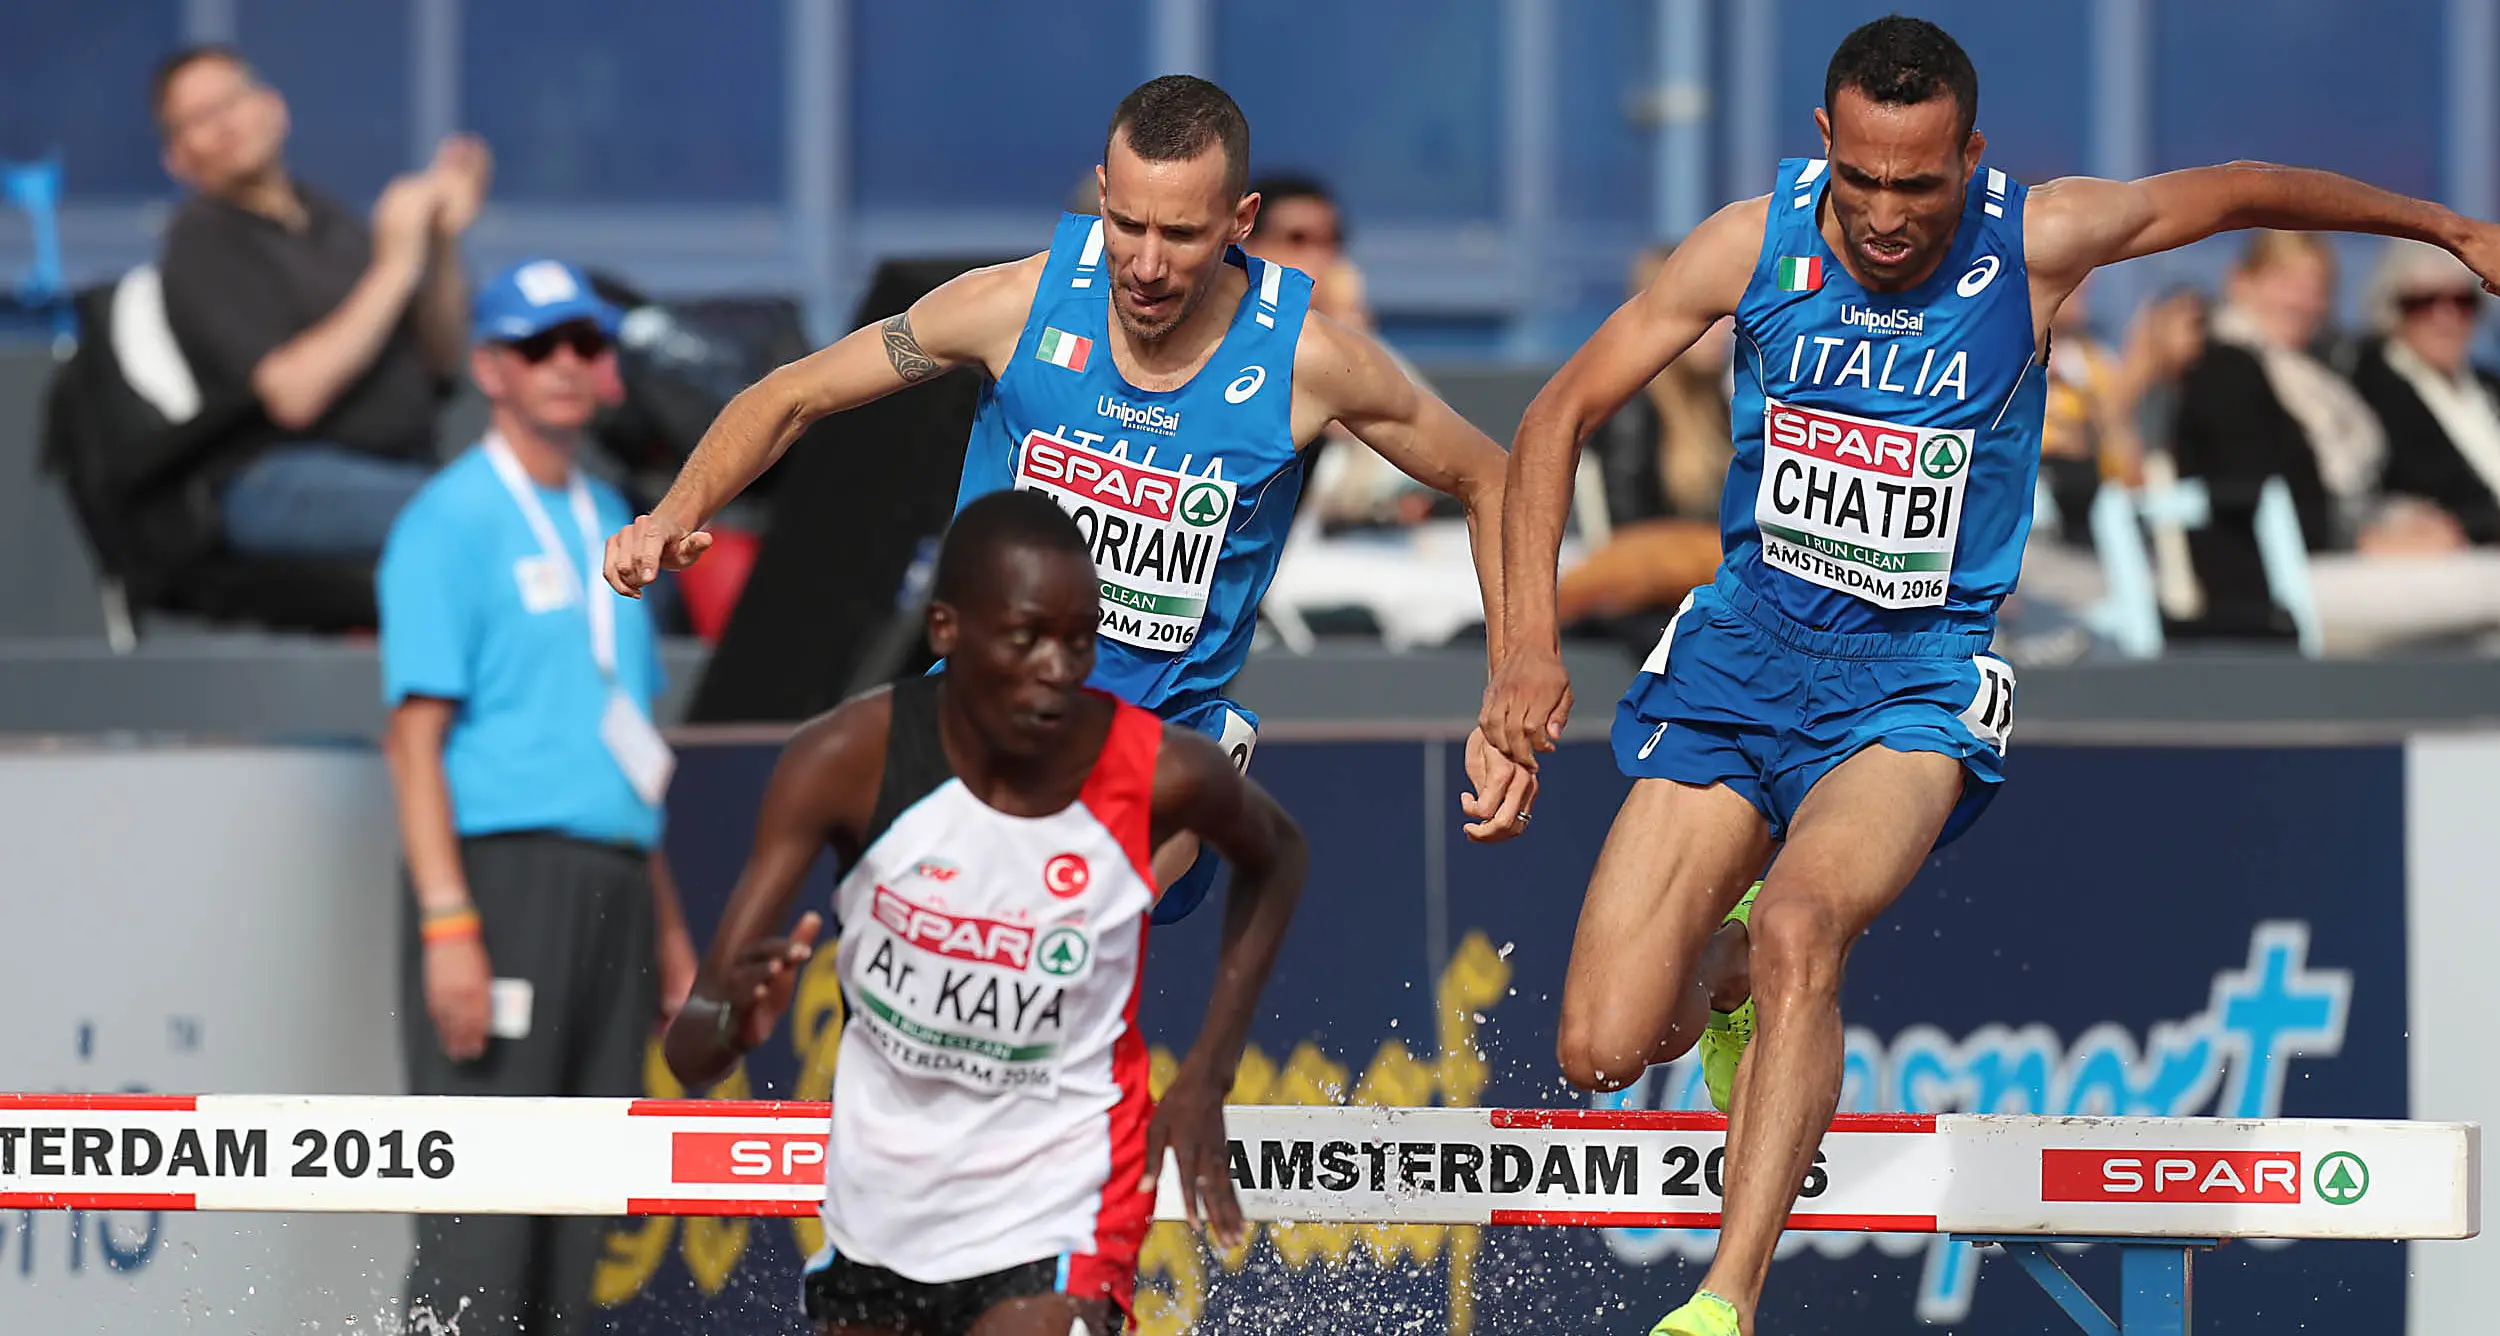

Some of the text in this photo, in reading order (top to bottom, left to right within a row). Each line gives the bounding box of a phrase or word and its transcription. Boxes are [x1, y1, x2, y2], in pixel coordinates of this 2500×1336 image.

[1841, 304, 1924, 333] UnipolSai
[1789, 335, 1968, 400] ITALIA
[1097, 395, 1180, 430] UnipolSai
[1774, 413, 1913, 471] SPAR
[1028, 443, 1177, 515] SPAR
[1773, 458, 1953, 539] CHATBI
[1028, 486, 1213, 585] ORIANI
[1804, 534, 1906, 571] I RUN CLEAN
[1100, 583, 1157, 611] CLEAN
[1767, 542, 1943, 600] AMSTERDAM 2016
[1147, 622, 1195, 644] 2016
[877, 892, 1031, 967] SPAR
[867, 939, 1064, 1033] Ar. KAYA
[1001, 1067, 1051, 1086] 2016
[291, 1129, 455, 1180] 2016
[730, 1141, 824, 1176] SP
[1225, 1139, 1829, 1199] AMSTERDAM 206
[2102, 1158, 2296, 1194] SPAR
